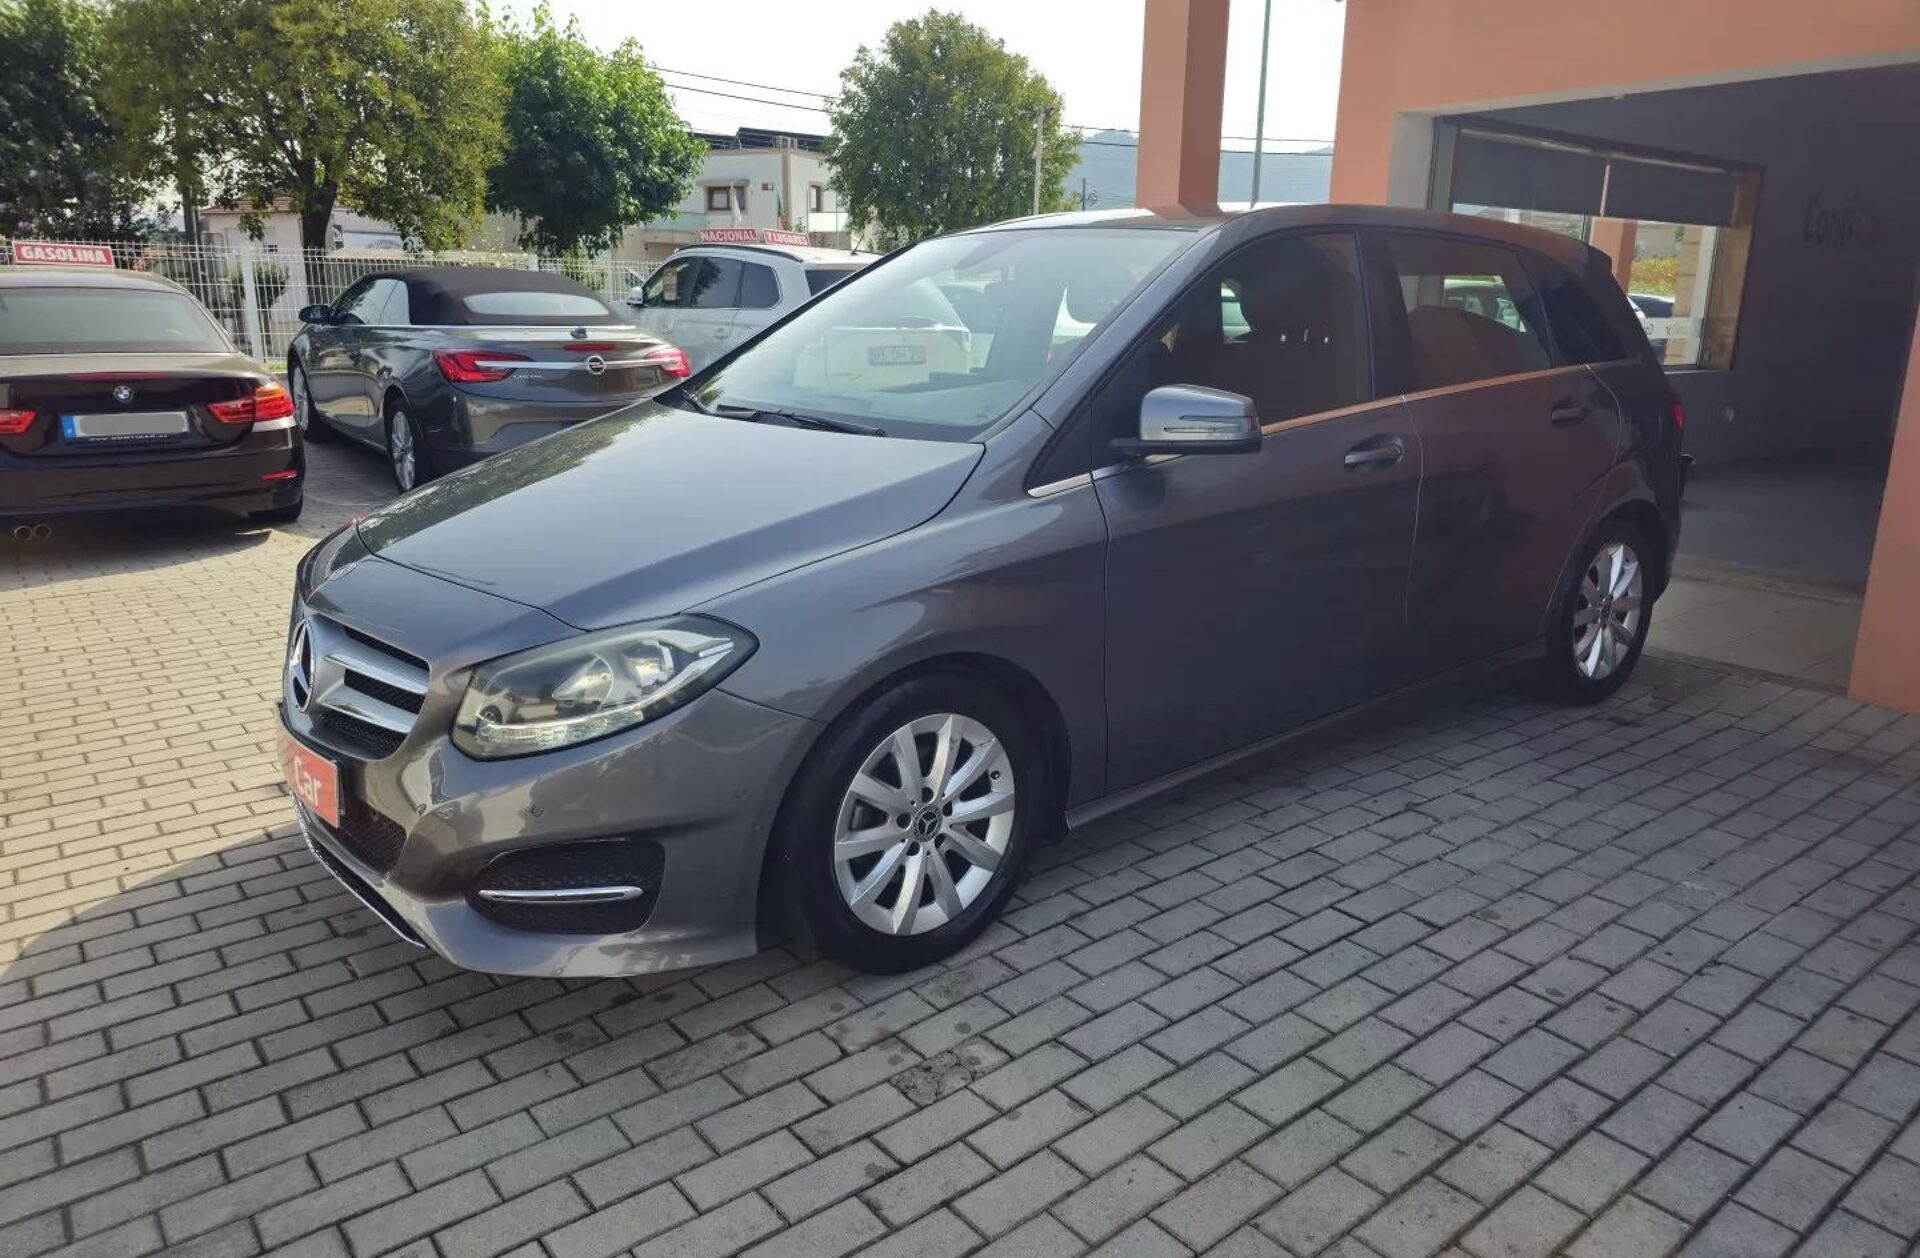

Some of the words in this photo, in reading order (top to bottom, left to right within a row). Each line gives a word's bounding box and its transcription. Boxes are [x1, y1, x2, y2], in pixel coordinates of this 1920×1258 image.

[700, 229, 756, 242] NACIONAL
[21, 245, 108, 263] GASOLINA
[293, 755, 322, 807] Car
